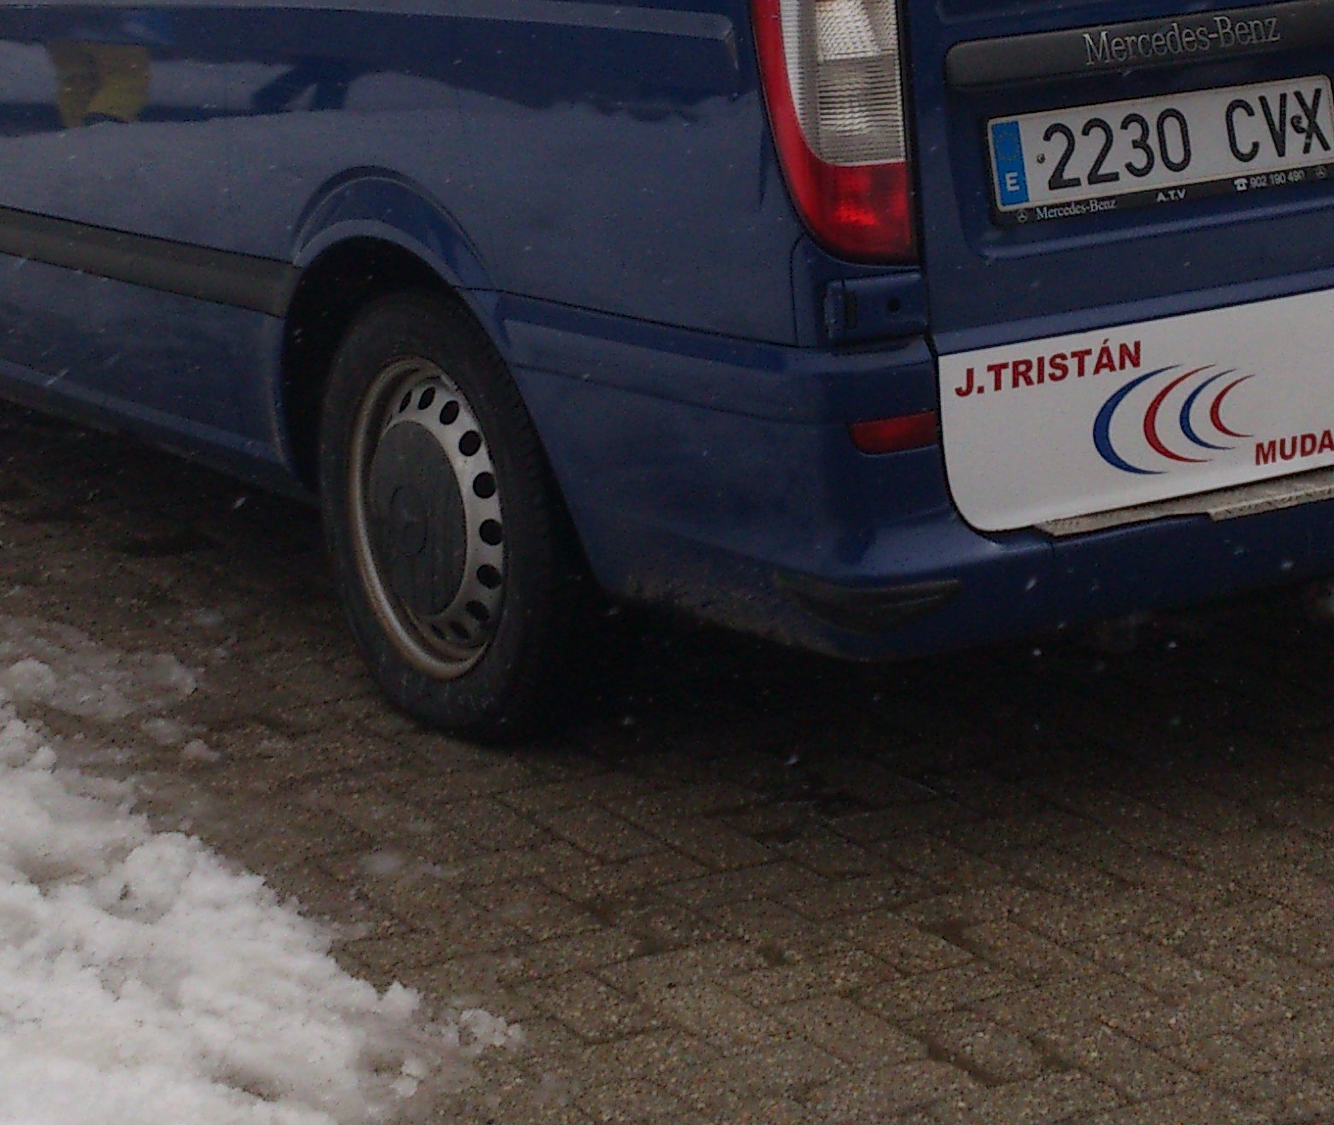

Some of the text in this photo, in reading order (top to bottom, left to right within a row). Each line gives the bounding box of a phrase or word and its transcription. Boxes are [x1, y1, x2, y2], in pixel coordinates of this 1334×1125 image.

[1082, 14, 1281, 66] Mercedes-Benz
[1005, 88, 1331, 192] E 2230 CVX
[1034, 198, 1117, 221] Mercedes-Benz
[955, 339, 1142, 398] J.TRISTÁN
